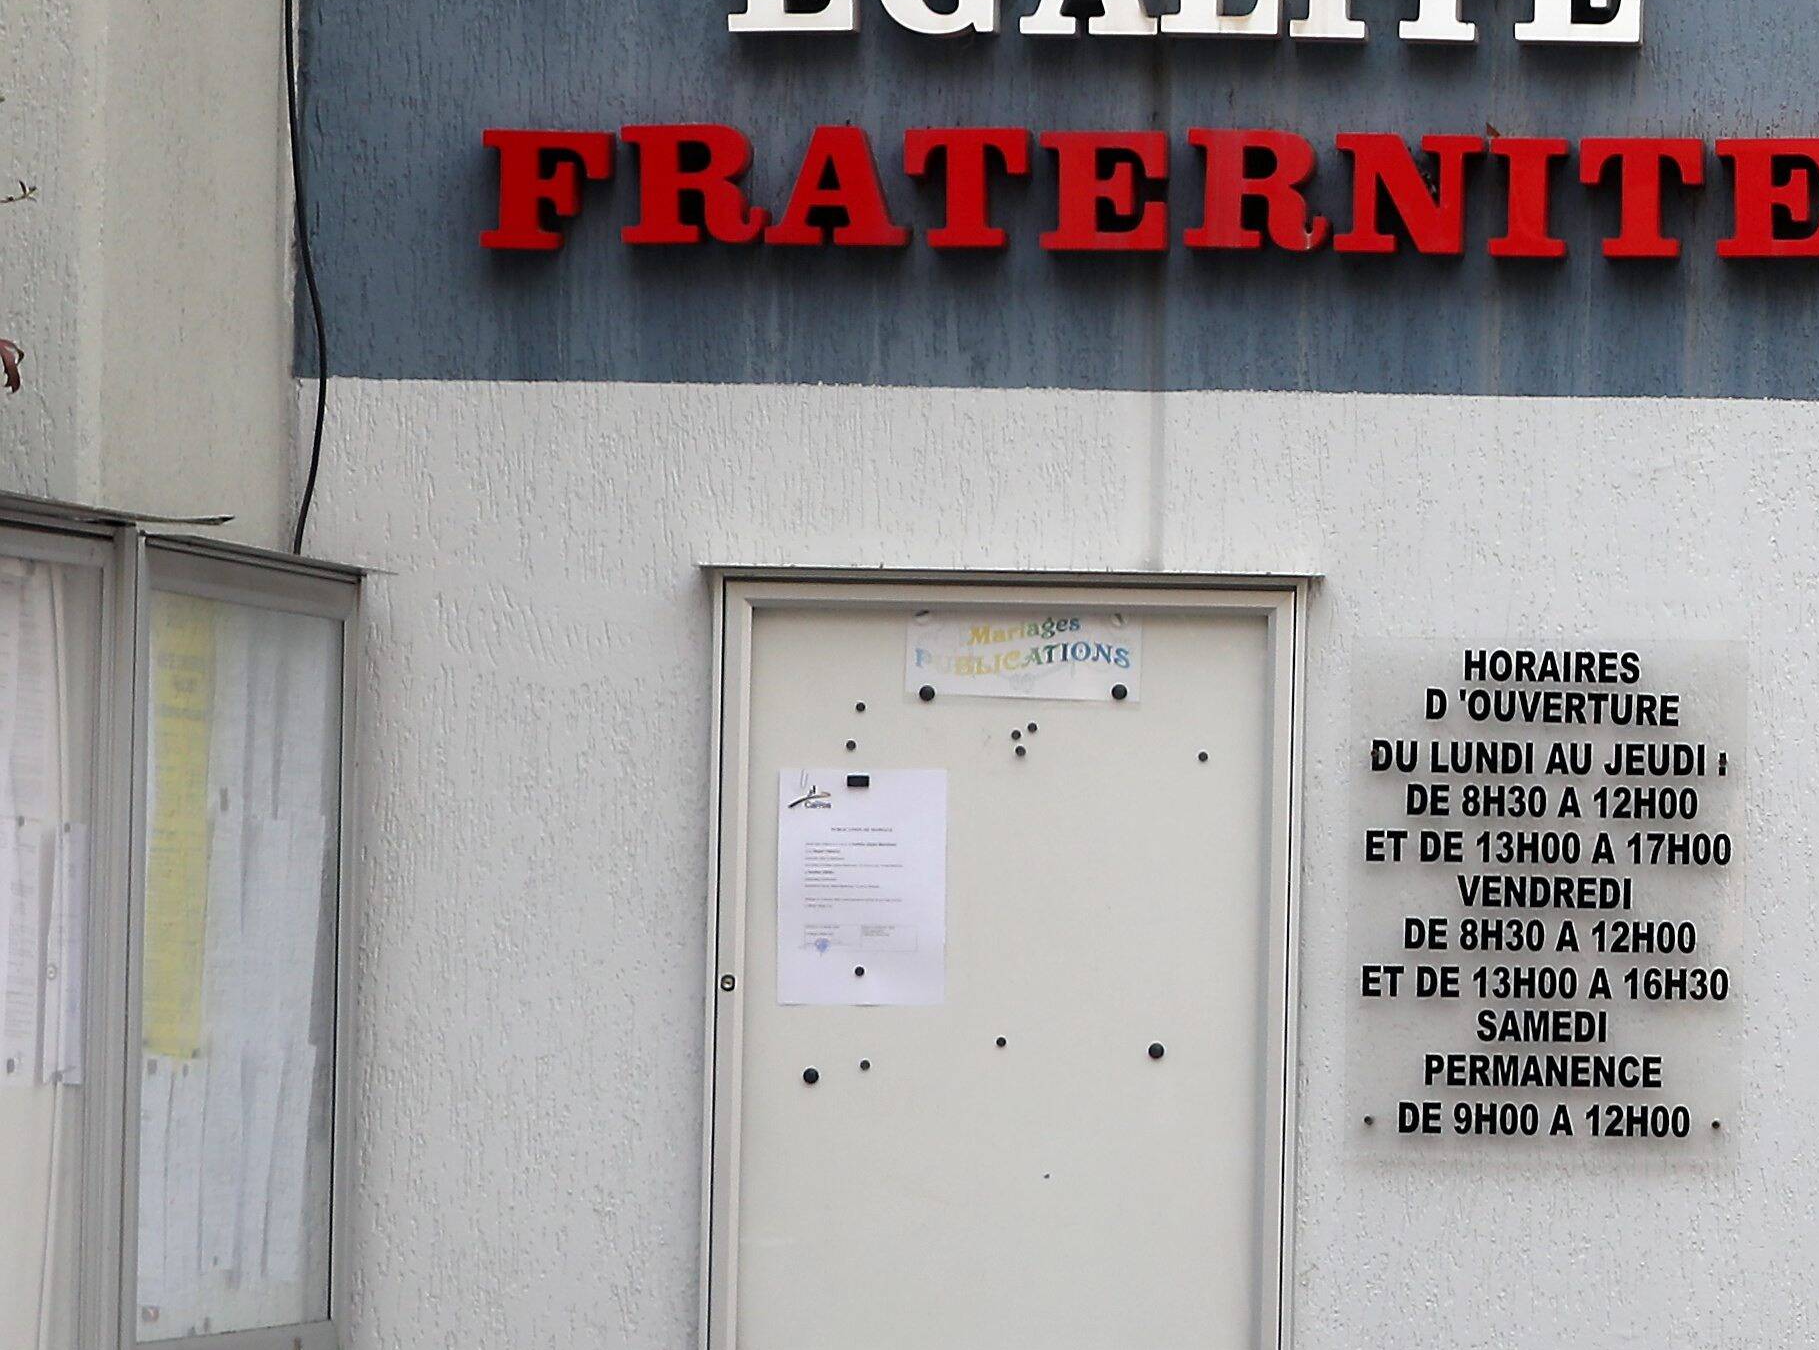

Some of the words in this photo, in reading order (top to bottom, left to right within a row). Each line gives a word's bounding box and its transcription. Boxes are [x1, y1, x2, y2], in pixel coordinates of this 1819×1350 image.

[966, 617, 1081, 646] Mariages
[1463, 650, 1641, 684] HORAIRES
[1371, 739, 1418, 773] DU
[1431, 742, 1534, 775] LUNDI
[1545, 743, 1592, 775] AU
[1604, 744, 1706, 776] JEUDI
[1406, 783, 1450, 817] DE
[1461, 785, 1547, 818] 8H30
[1557, 786, 1581, 818] A
[1593, 787, 1699, 820] 12H00
[1366, 830, 1408, 862] ET
[1420, 831, 1464, 863] DE
[1476, 831, 1581, 865] 13H00
[1592, 833, 1616, 865] A
[1627, 833, 1732, 866] 17H00
[1458, 874, 1632, 909] VENDREDI
[1404, 918, 1448, 950] DE
[1459, 918, 1545, 952] 8H30
[1556, 920, 1579, 952] A
[1591, 921, 1696, 954] 12H00
[1361, 965, 1405, 997] ET
[1416, 965, 1460, 998] DE
[1472, 966, 1578, 1000] 13H00
[1588, 967, 1612, 1000] A
[1623, 968, 1730, 1001] 16H30
[1475, 1009, 1607, 1043] SAMEDI
[1425, 1054, 1663, 1088] PERMANENCE
[1398, 1102, 1442, 1134] DE
[1453, 1102, 1539, 1136] 9H00
[1550, 1104, 1574, 1136] A
[1585, 1104, 1691, 1138] 12H00
